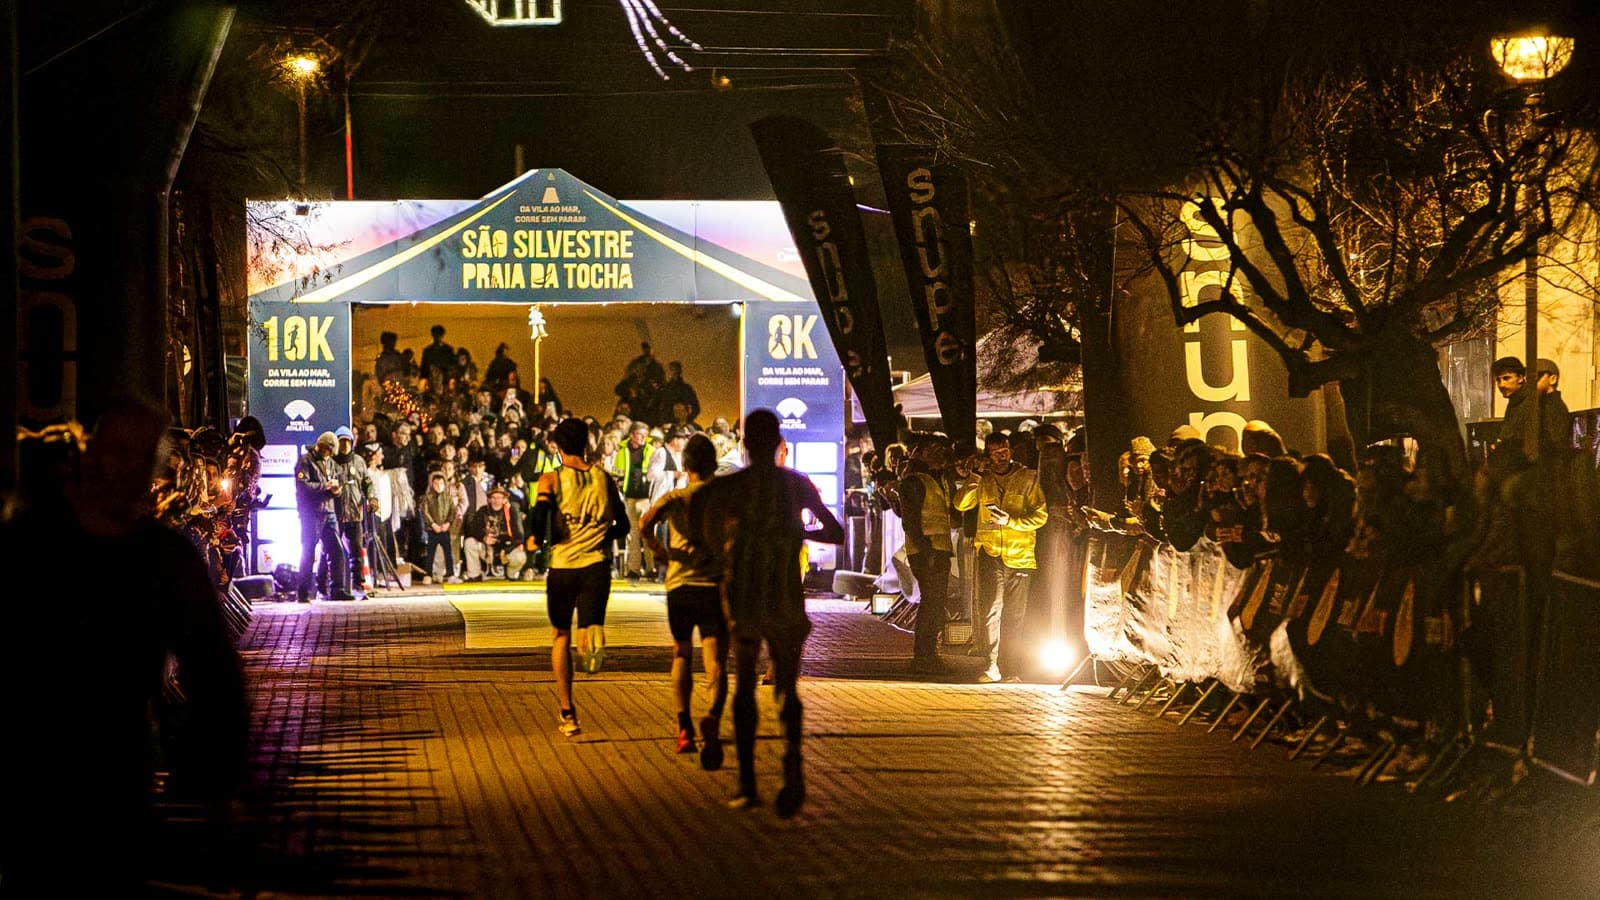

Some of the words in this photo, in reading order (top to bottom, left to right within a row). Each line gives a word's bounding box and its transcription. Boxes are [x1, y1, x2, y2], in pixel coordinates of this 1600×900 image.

[462, 225, 508, 259] SÃO
[512, 229, 634, 259] SILVESTRE
[462, 263, 526, 289] PRAIA
[530, 263, 560, 289] DA
[563, 263, 633, 289] TOCHA
[263, 315, 335, 362] 10K
[767, 313, 819, 360] 8K
[280, 369, 298, 377] VILA
